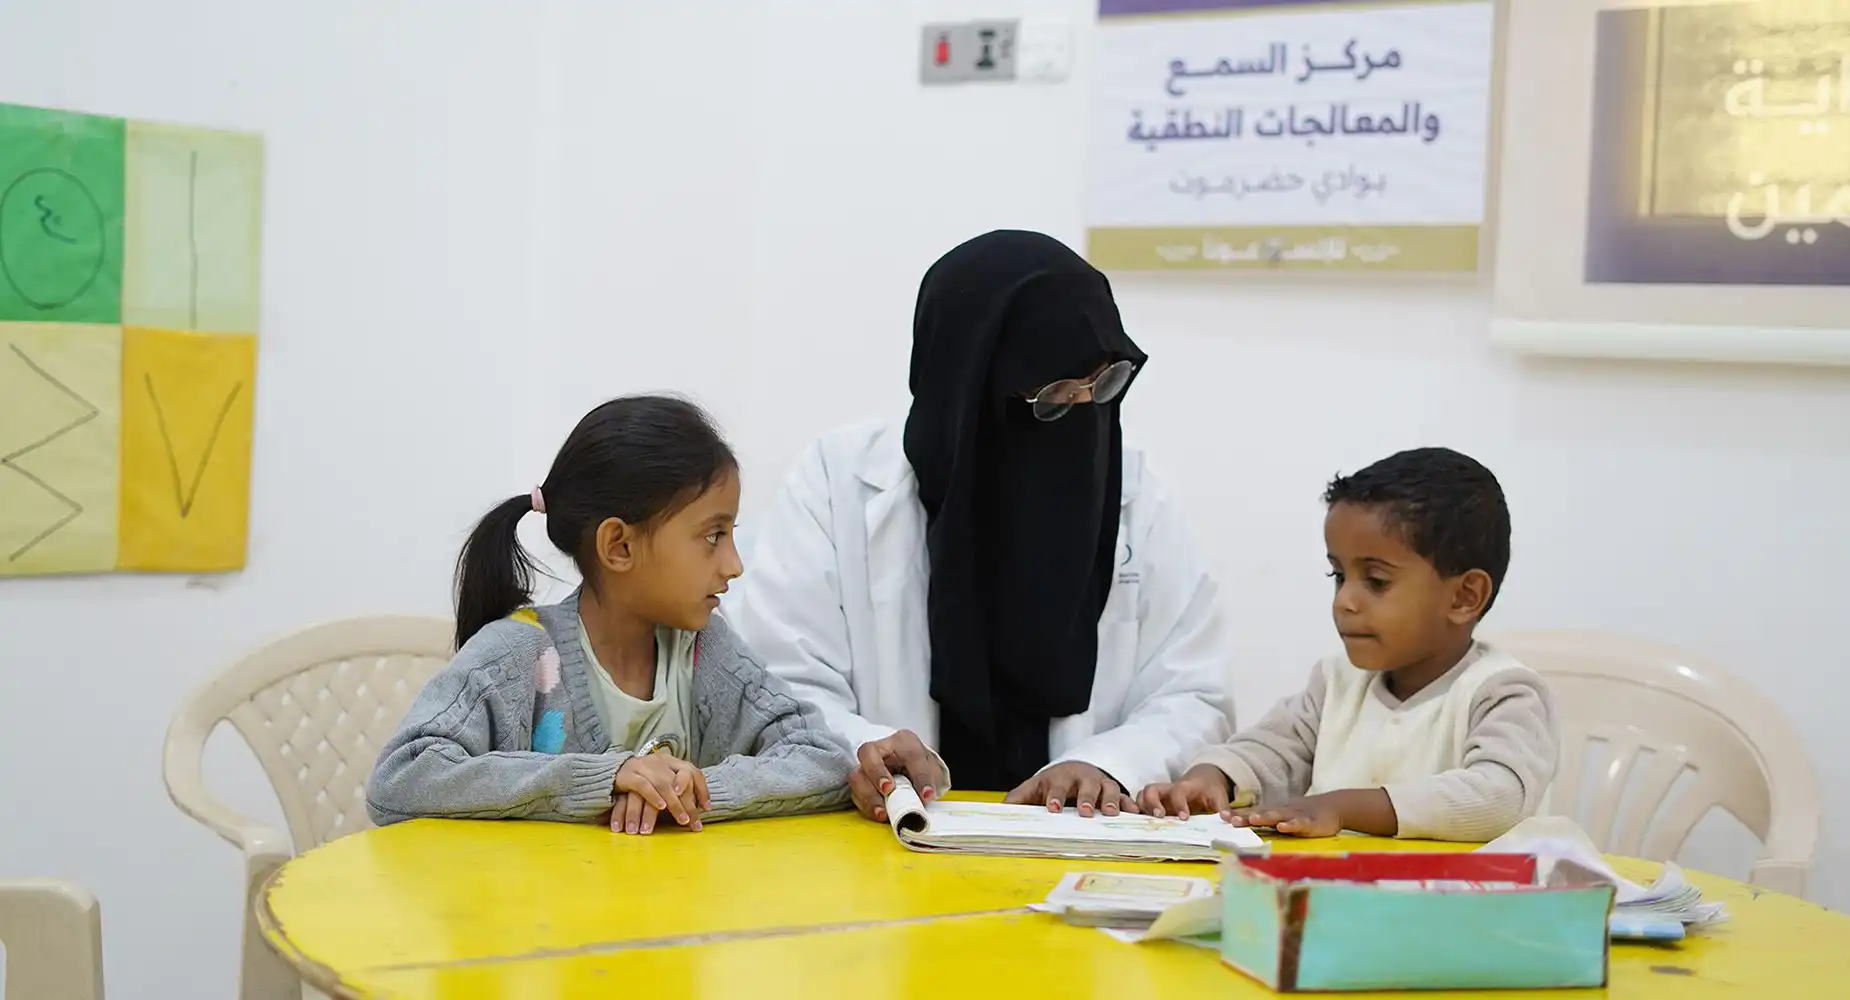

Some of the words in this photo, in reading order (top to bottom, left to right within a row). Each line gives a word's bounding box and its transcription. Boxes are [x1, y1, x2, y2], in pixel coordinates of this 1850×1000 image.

[1165, 43, 1286, 96] السمع
[1297, 38, 1402, 83] مركز
[1127, 107, 1243, 152] النطقية
[1254, 100, 1440, 148] والمعالجات
[1310, 163, 1387, 206] بوادي
